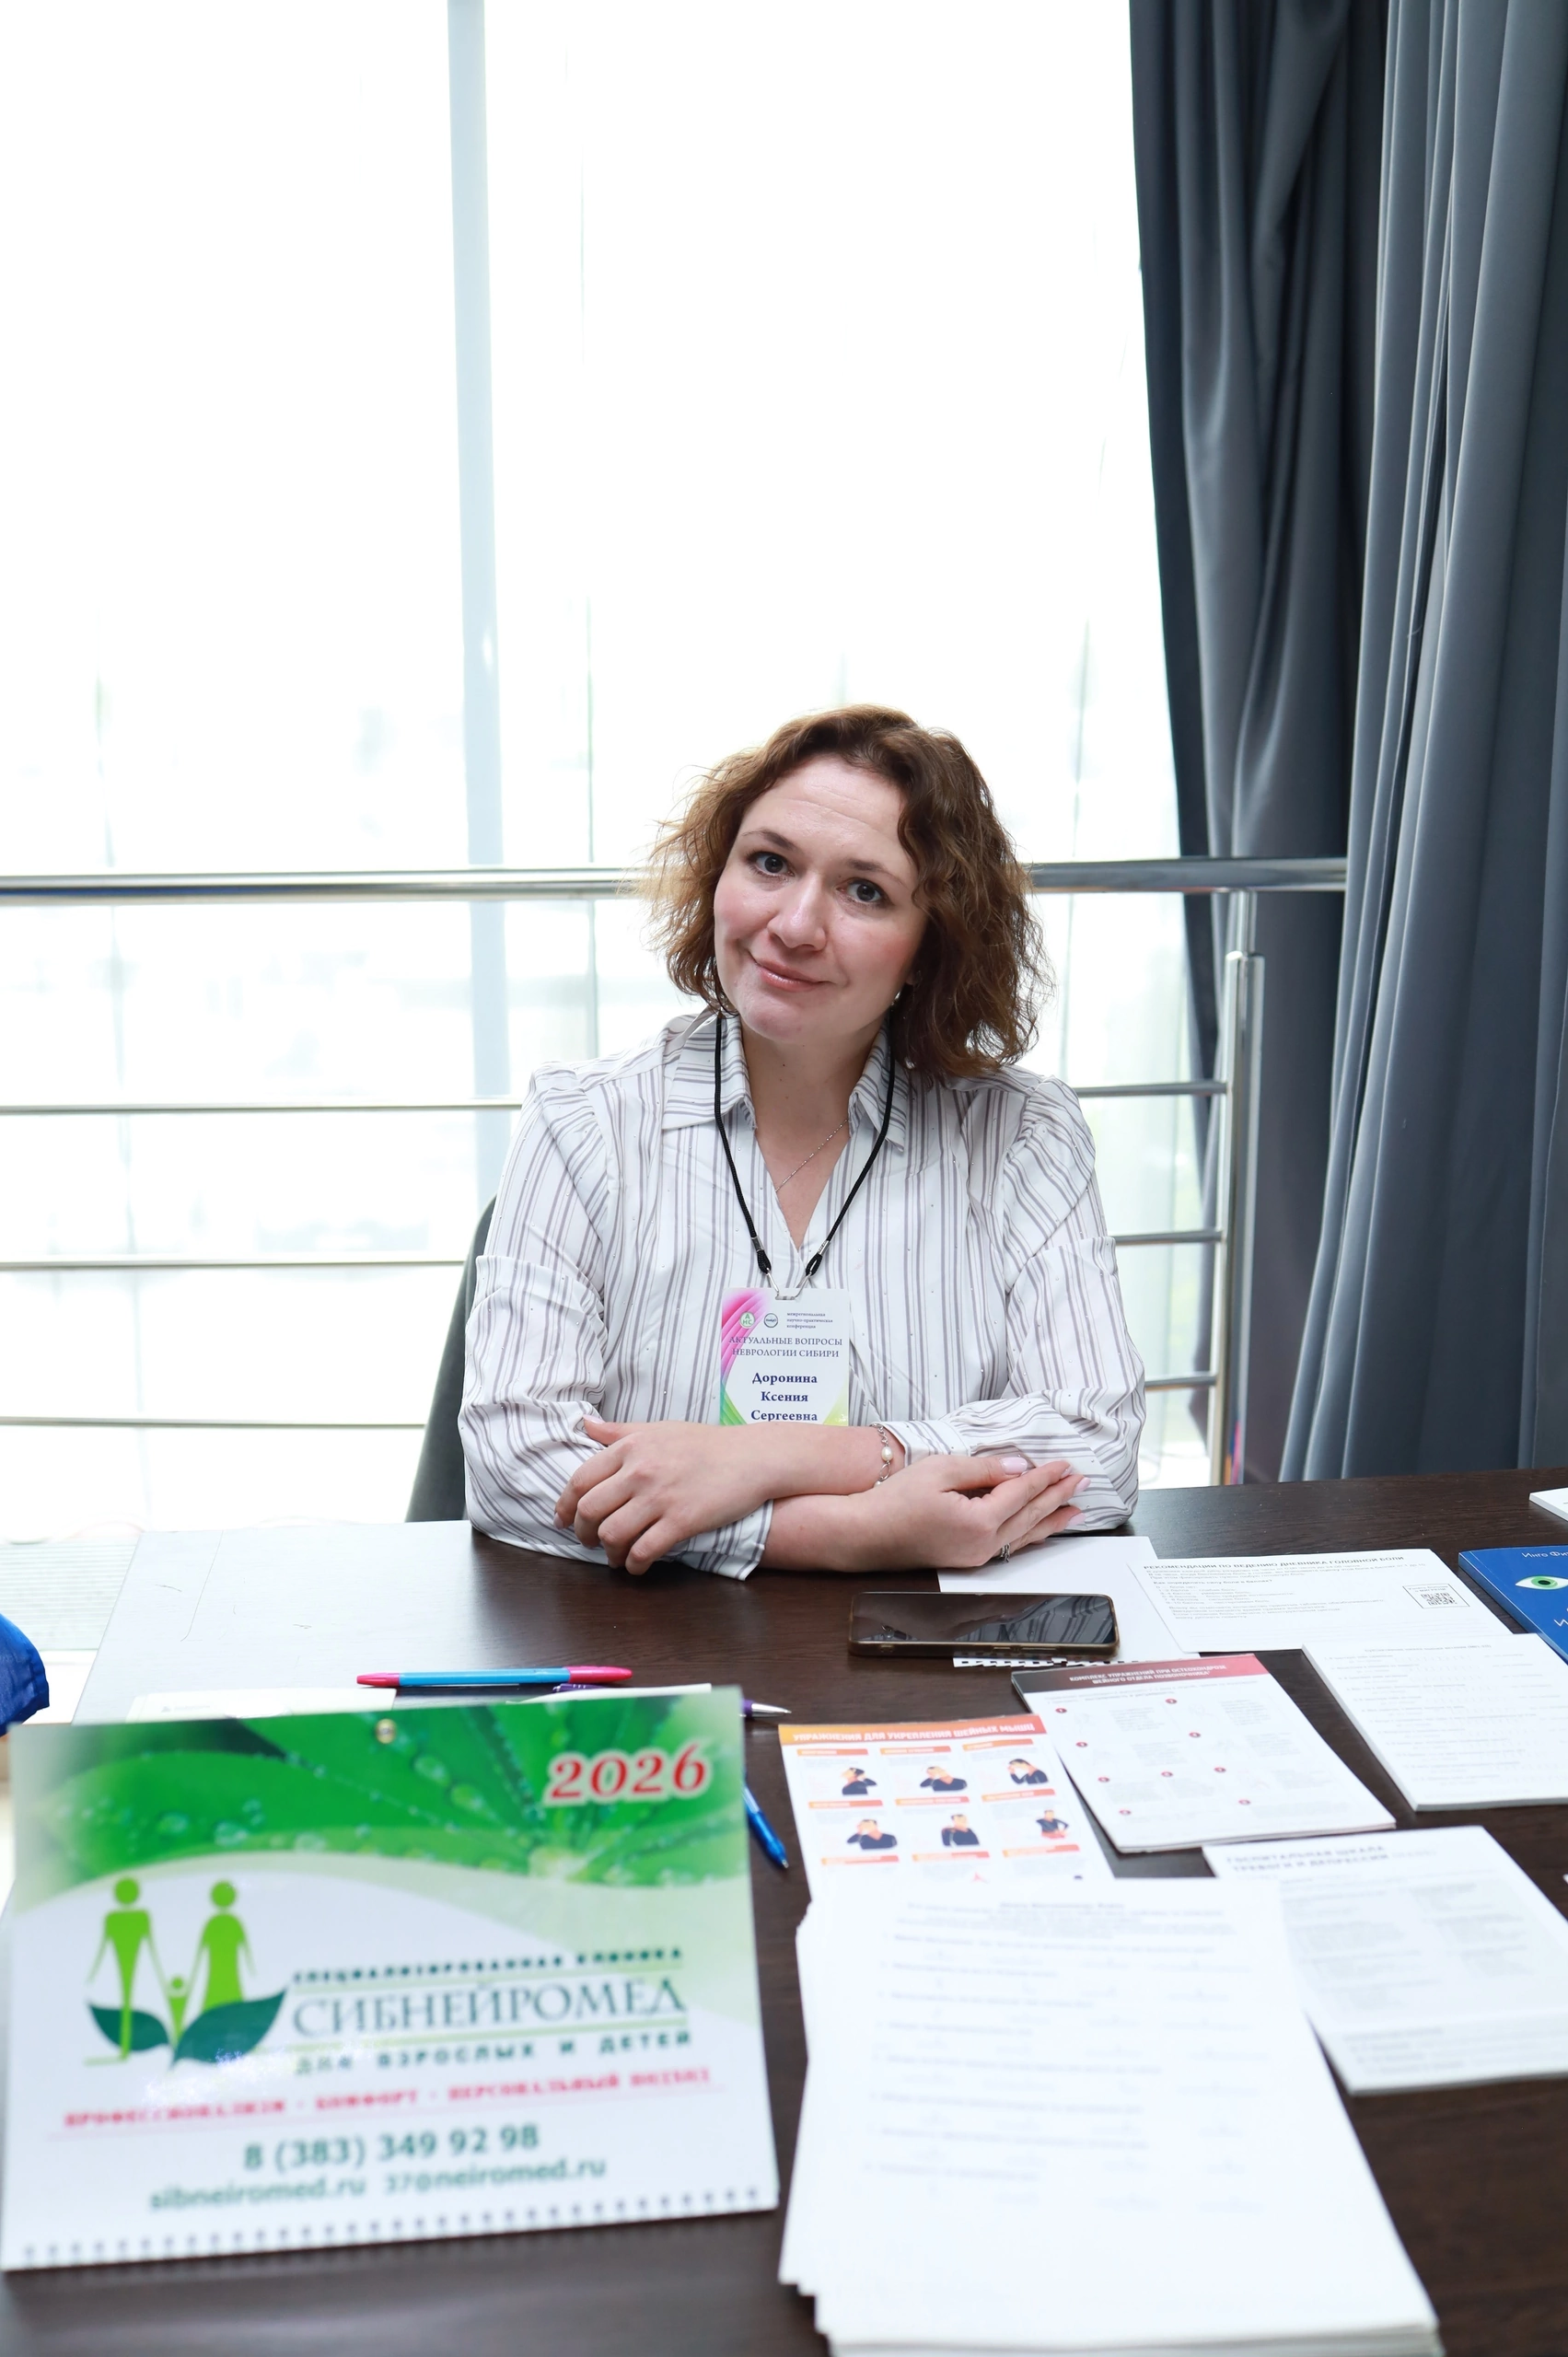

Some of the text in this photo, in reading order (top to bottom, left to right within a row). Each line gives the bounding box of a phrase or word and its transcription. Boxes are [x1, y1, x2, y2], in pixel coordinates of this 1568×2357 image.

[795, 1338, 842, 1346] ВОПРОСЫ
[751, 1373, 818, 1386] Доронина
[761, 1391, 808, 1401] Ксения
[751, 1410, 818, 1422] Сергеевна
[1069, 1673, 1107, 1682] КОМПЛЕКС
[1108, 1669, 1155, 1678] УПРАЖНЕНИЙ
[1171, 1665, 1226, 1673] ОСТЕОХОНДРОЗЕ
[1093, 1676, 1125, 1684] ШЕЙНОГО
[793, 1723, 1035, 1742] УПРАЖНЕНИЯ ДЛЯ УКРЕПЛЕНИЯ ШЕЙНЫХ МЫШЦ
[552, 1744, 706, 1798] 2026
[293, 1977, 687, 2038] СИБНЕЙРОМЕД
[598, 2030, 691, 2055] ДЕТЕЙ
[274, 2133, 366, 2174] (383)
[378, 2131, 438, 2161] 349
[448, 2127, 488, 2155] 92
[500, 2122, 540, 2151] 98
